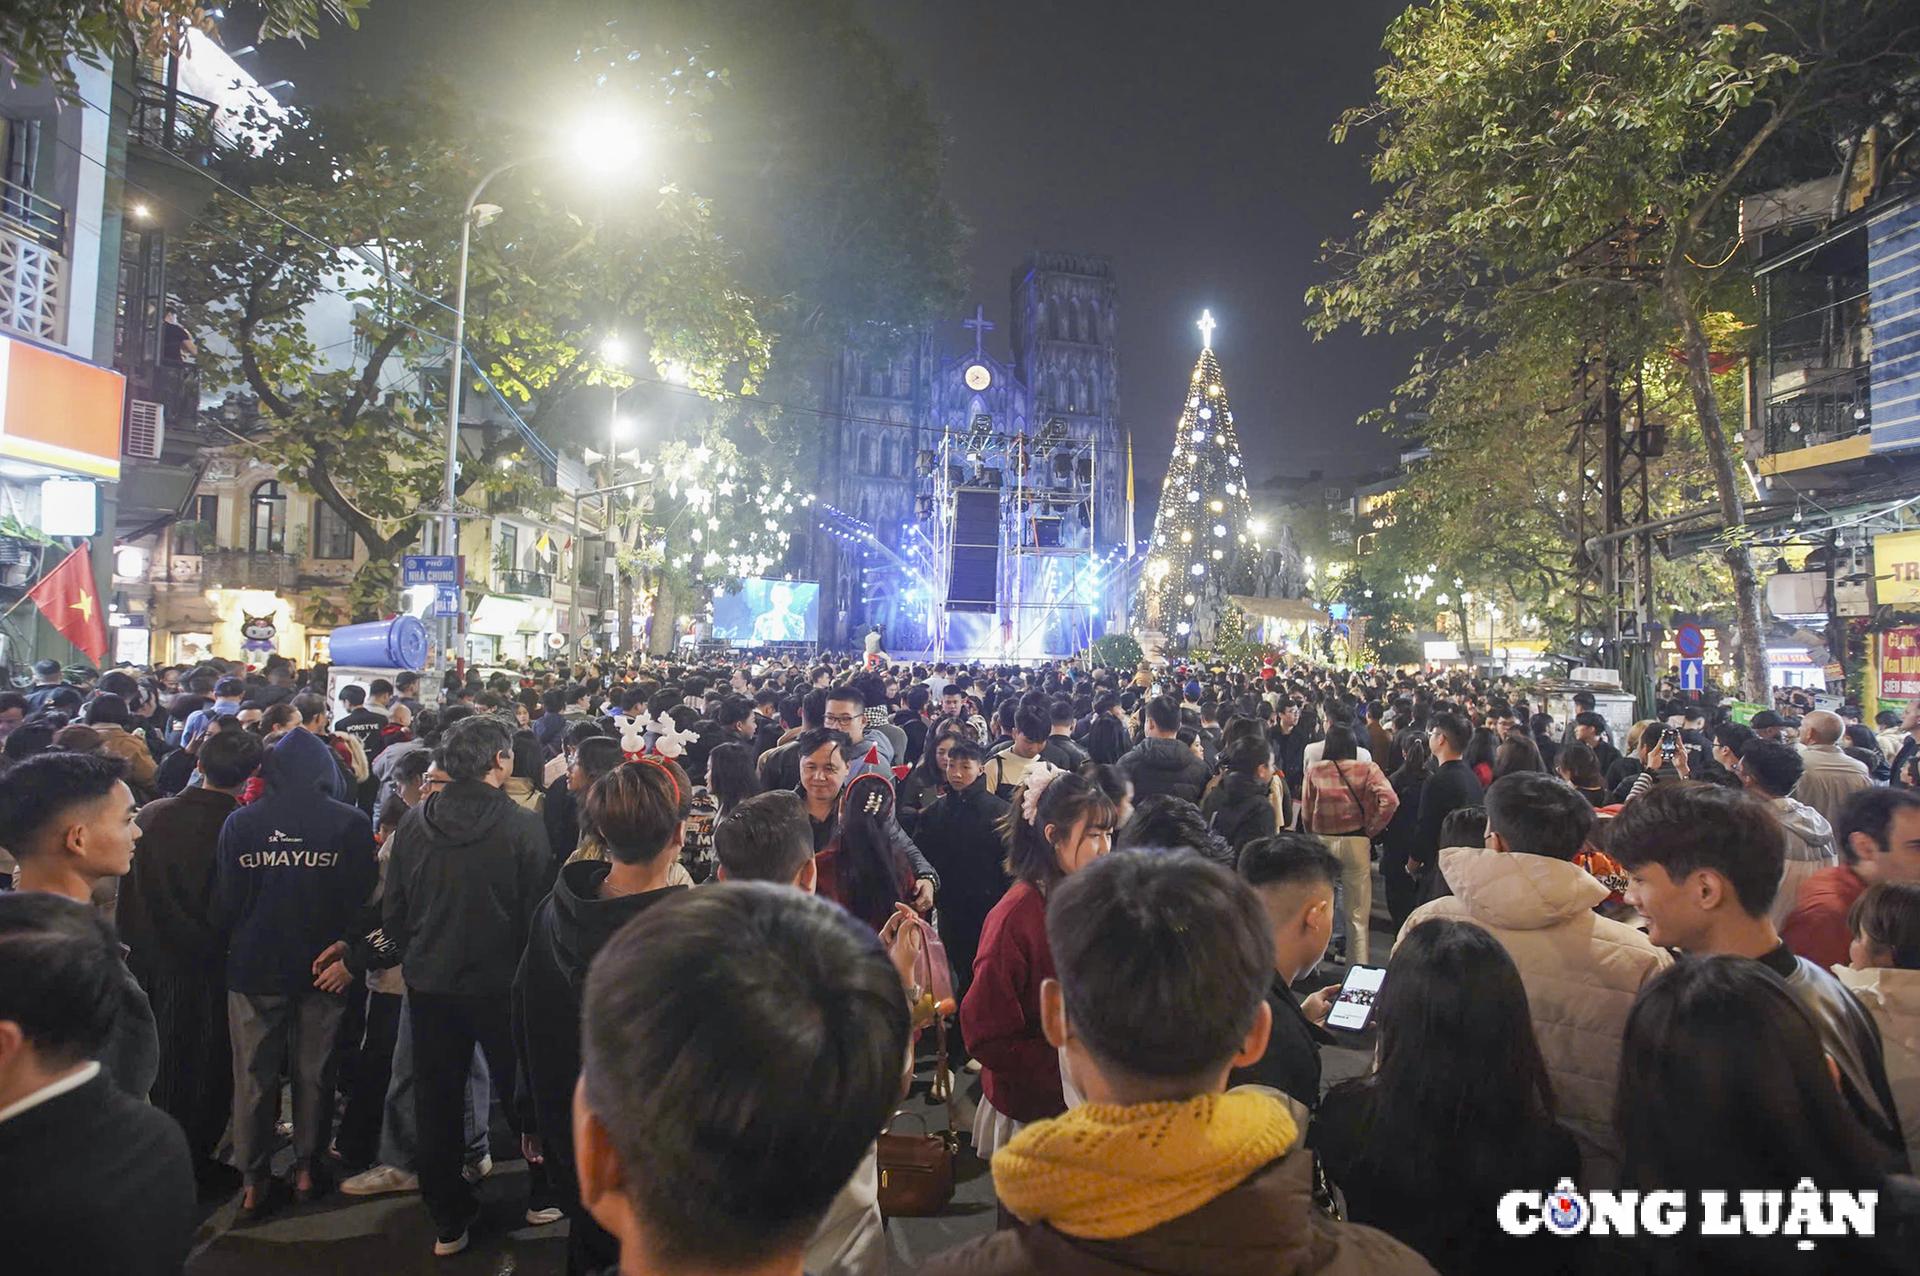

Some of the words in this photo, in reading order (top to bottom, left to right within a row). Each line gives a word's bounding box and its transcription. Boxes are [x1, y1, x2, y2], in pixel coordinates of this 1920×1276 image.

[408, 568, 426, 582] NHÀ
[427, 570, 454, 582] CHUNG
[268, 835, 279, 843] SK
[239, 850, 339, 868] GUMAYUSI
